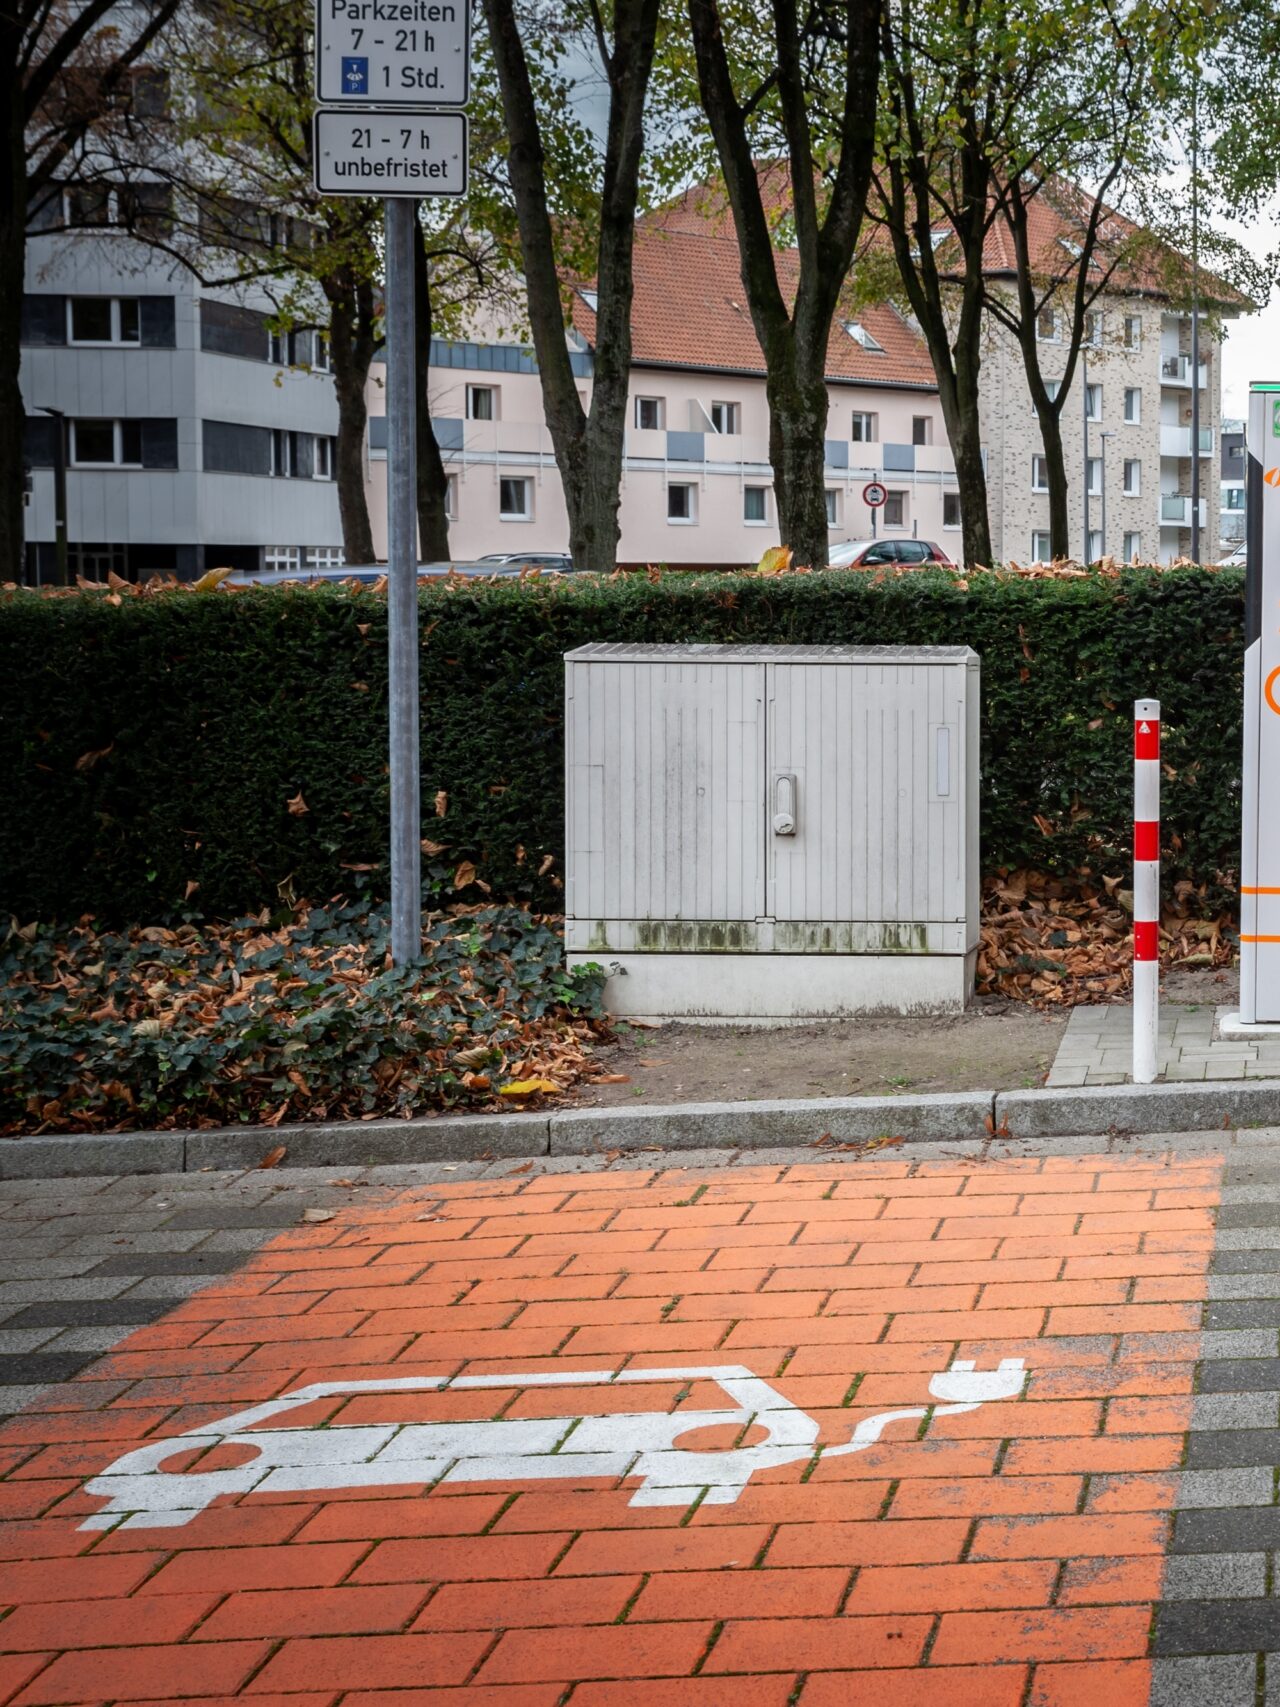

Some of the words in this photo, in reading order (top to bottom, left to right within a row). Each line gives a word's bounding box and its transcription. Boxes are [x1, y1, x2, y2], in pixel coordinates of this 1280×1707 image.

[331, 0, 455, 22] Parkzeiten
[351, 28, 364, 50] 7
[395, 29, 417, 52] 21
[425, 30, 435, 52] h
[382, 65, 390, 87] 1
[400, 66, 445, 89] Std.
[351, 128, 371, 149] 21
[400, 129, 412, 150] 7
[421, 129, 430, 150] h
[334, 157, 448, 178] unbefristet
